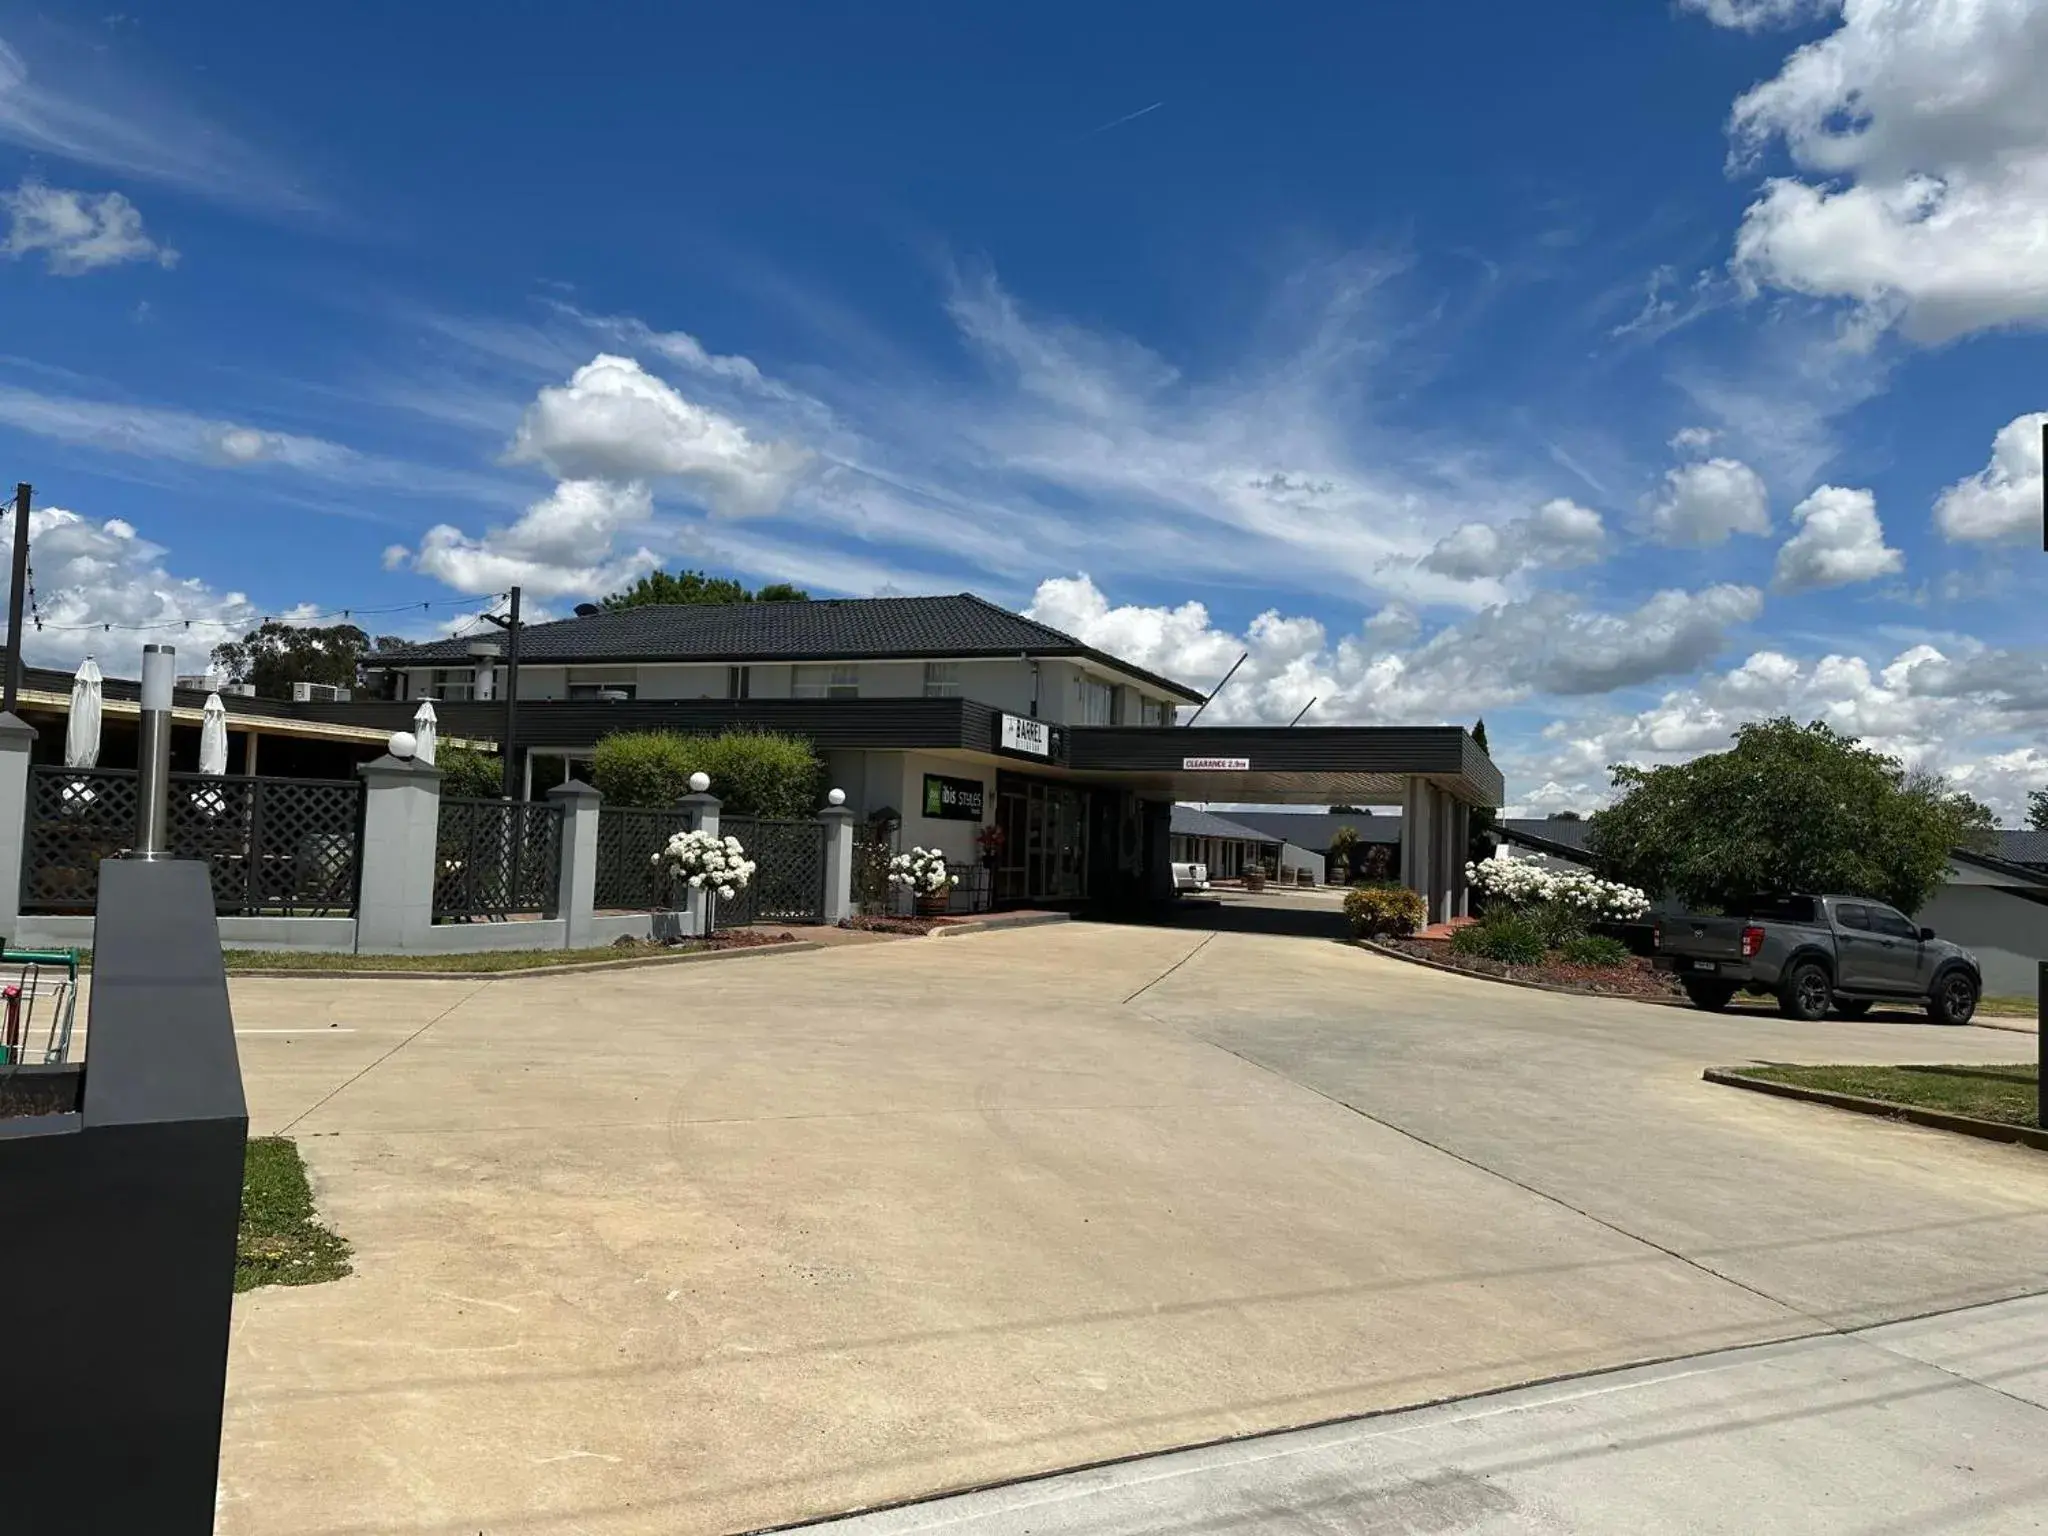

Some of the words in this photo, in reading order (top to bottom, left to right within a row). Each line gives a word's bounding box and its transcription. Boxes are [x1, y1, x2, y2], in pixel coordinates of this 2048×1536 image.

[1016, 719, 1042, 744] BARREL
[1186, 760, 1226, 768] CLEARANCE
[942, 785, 957, 805] ibis
[959, 792, 981, 807] STYLES
